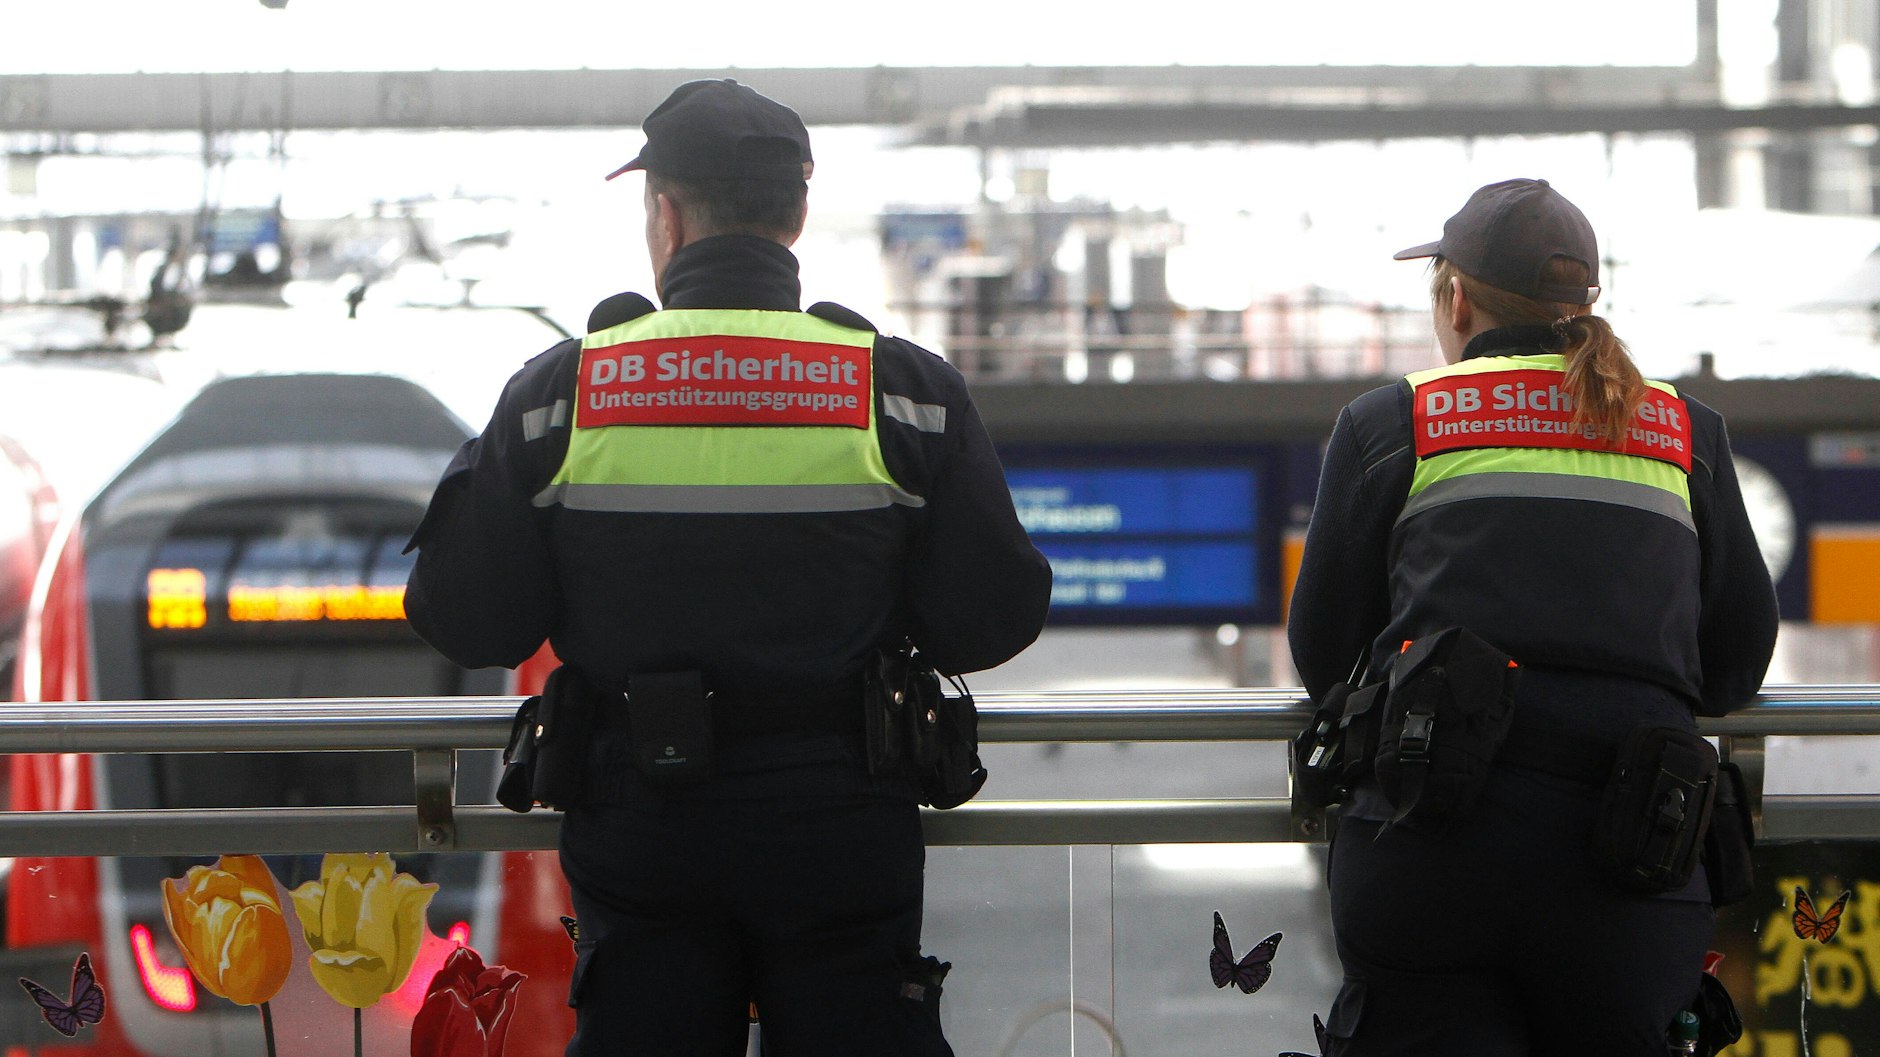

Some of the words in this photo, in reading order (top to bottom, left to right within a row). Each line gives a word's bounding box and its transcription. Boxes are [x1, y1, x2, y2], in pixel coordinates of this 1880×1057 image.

[590, 355, 645, 385] DB
[656, 350, 858, 385] Sicherheit
[590, 386, 857, 411] Unterstützungsgruppe
[1427, 387, 1481, 416] DB
[1493, 383, 1682, 431] Sicheit
